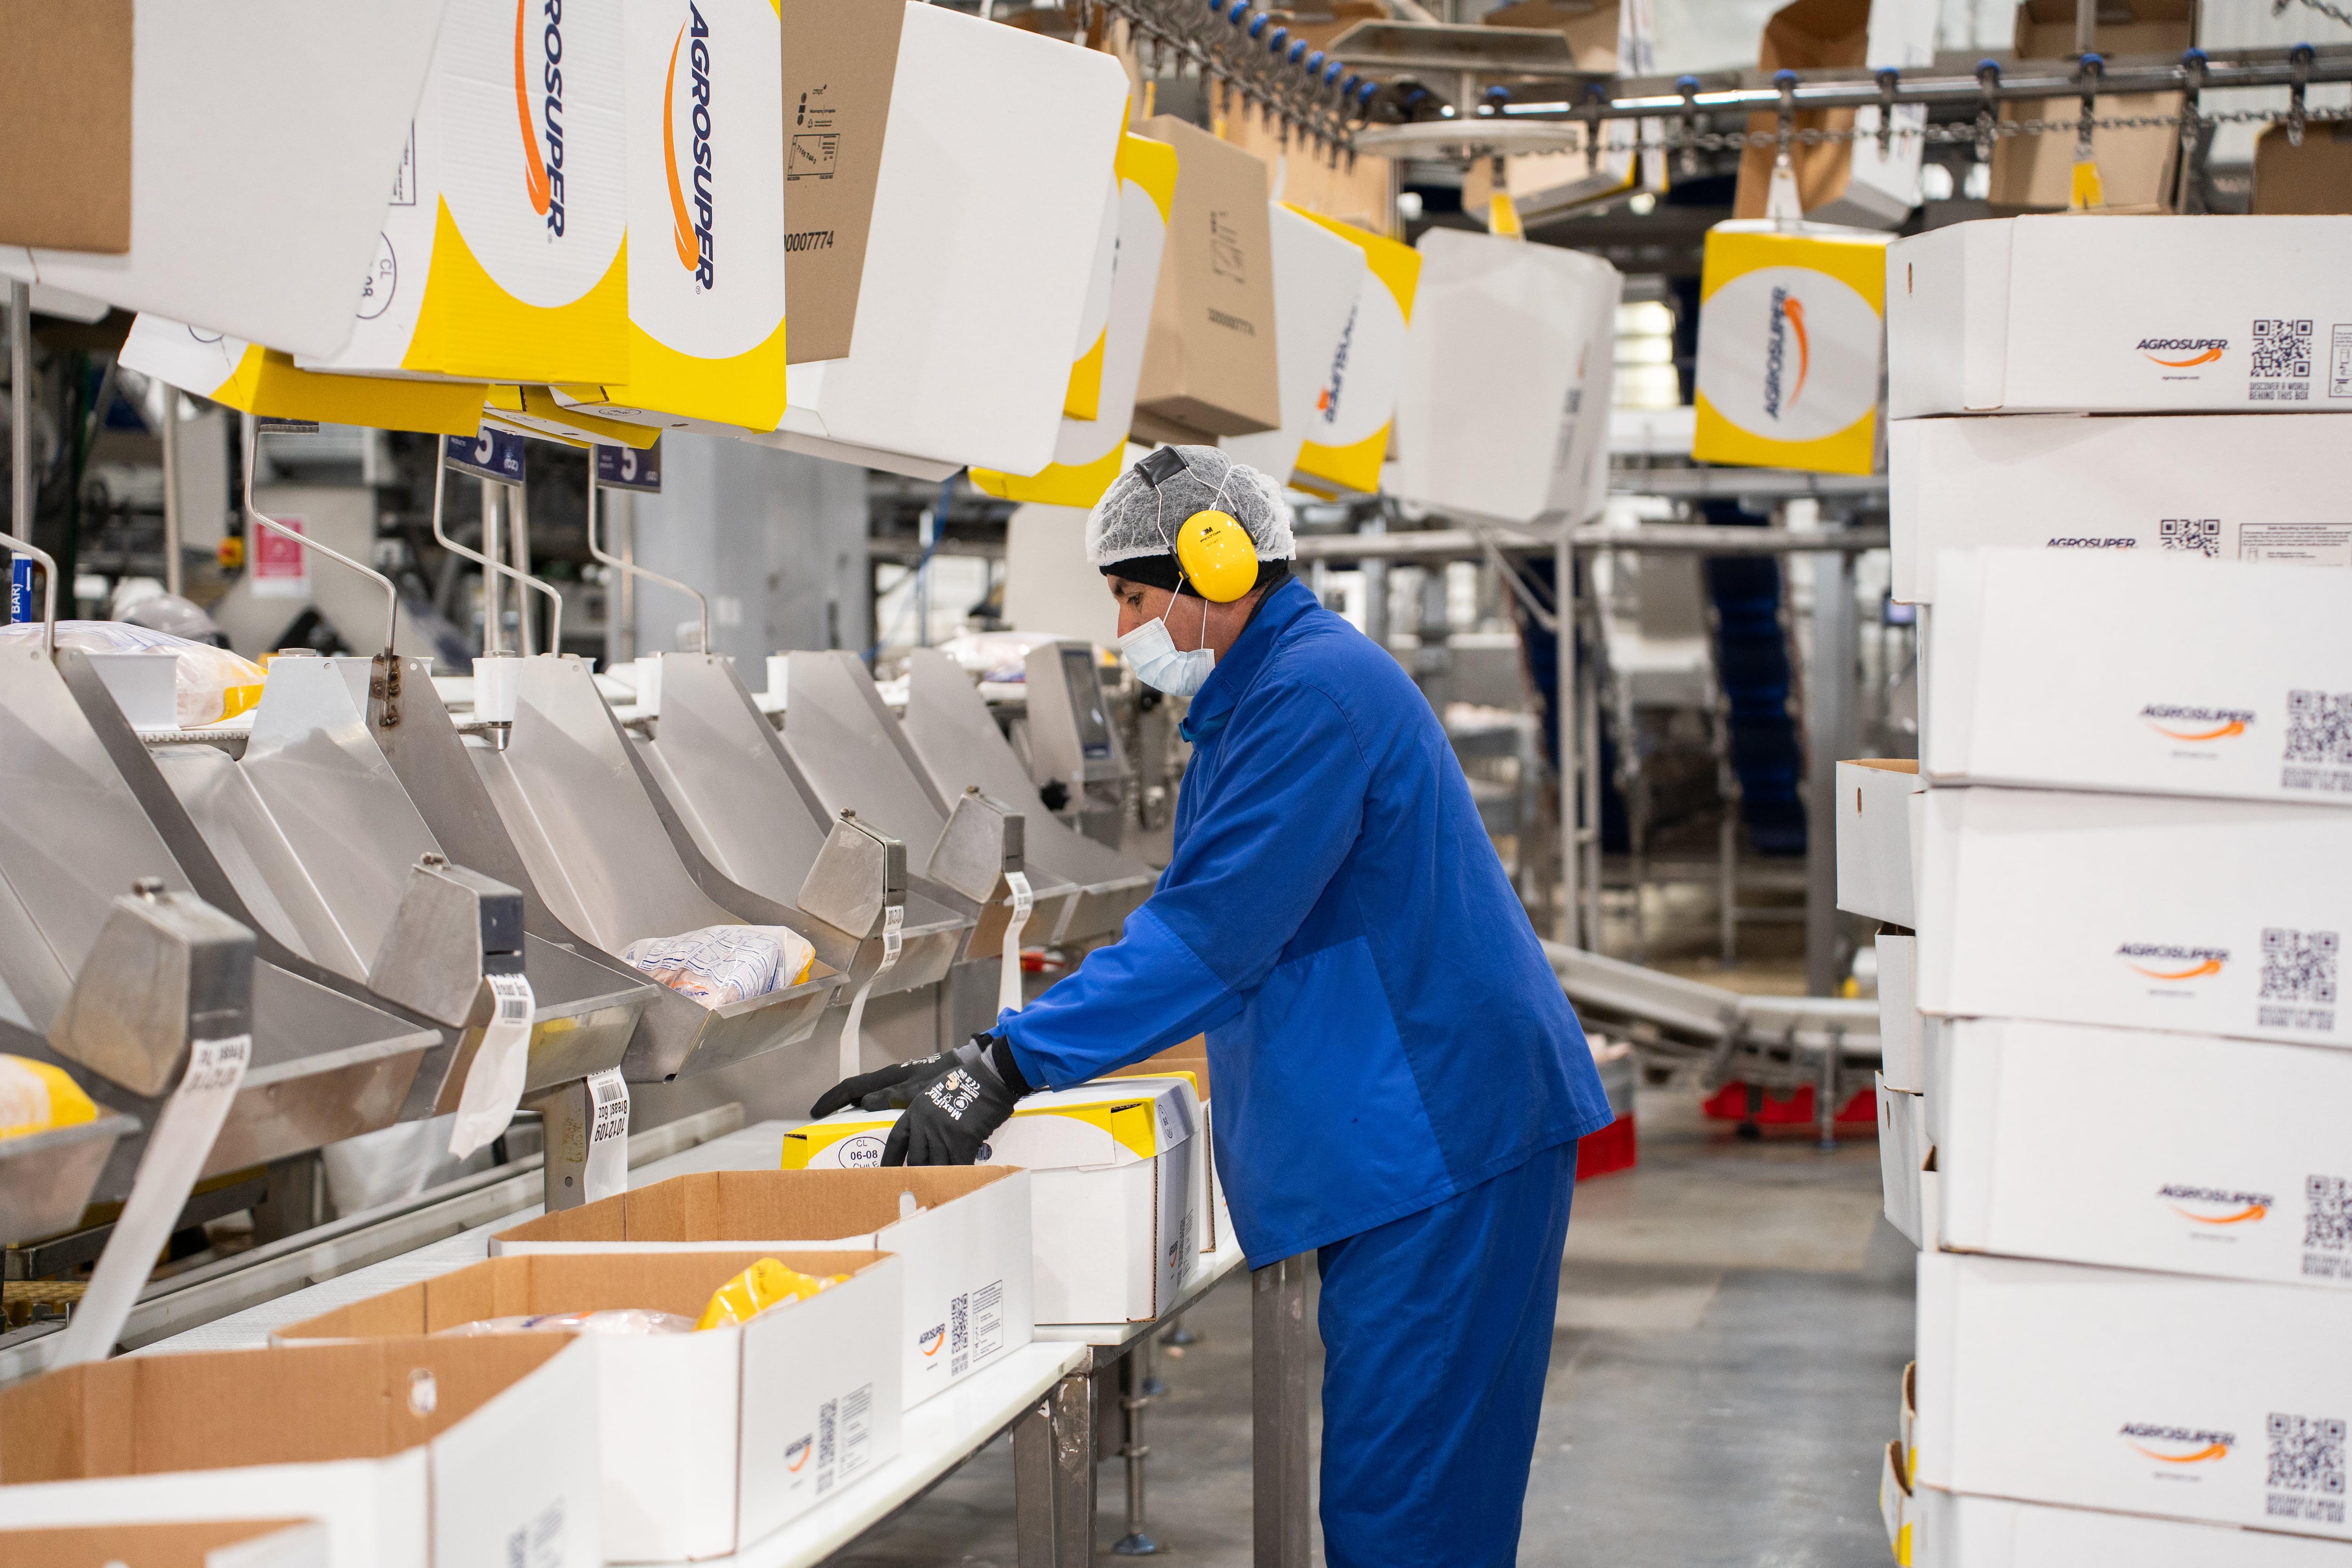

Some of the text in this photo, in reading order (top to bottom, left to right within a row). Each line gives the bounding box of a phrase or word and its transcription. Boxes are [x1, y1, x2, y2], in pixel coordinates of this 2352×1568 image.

[690, 0, 714, 290] AGROSUPER
[784, 231, 834, 252] 0007774
[380, 259, 392, 279] CL
[2136, 338, 2228, 350] AGROSUPER
[1764, 287, 1786, 422] AGROSUPER
[1200, 530, 1221, 543] PELTOR
[1201, 526, 1213, 536] 3M
[2046, 538, 2136, 549] AGROSUPER
[12, 583, 24, 614] BAR)
[2139, 704, 2256, 723] AGROSUPER
[2116, 942, 2230, 961] AGROSUPER
[598, 1100, 627, 1120] Breast 6oz
[927, 1089, 962, 1121] MaxiFlex
[595, 1117, 625, 1142] 1012109
[850, 1150, 878, 1160] 06-08
[2157, 1184, 2274, 1208] AGROSUPER
[919, 1323, 946, 1345] AGROSUPER
[2119, 1422, 2236, 1446] AGROSUPER
